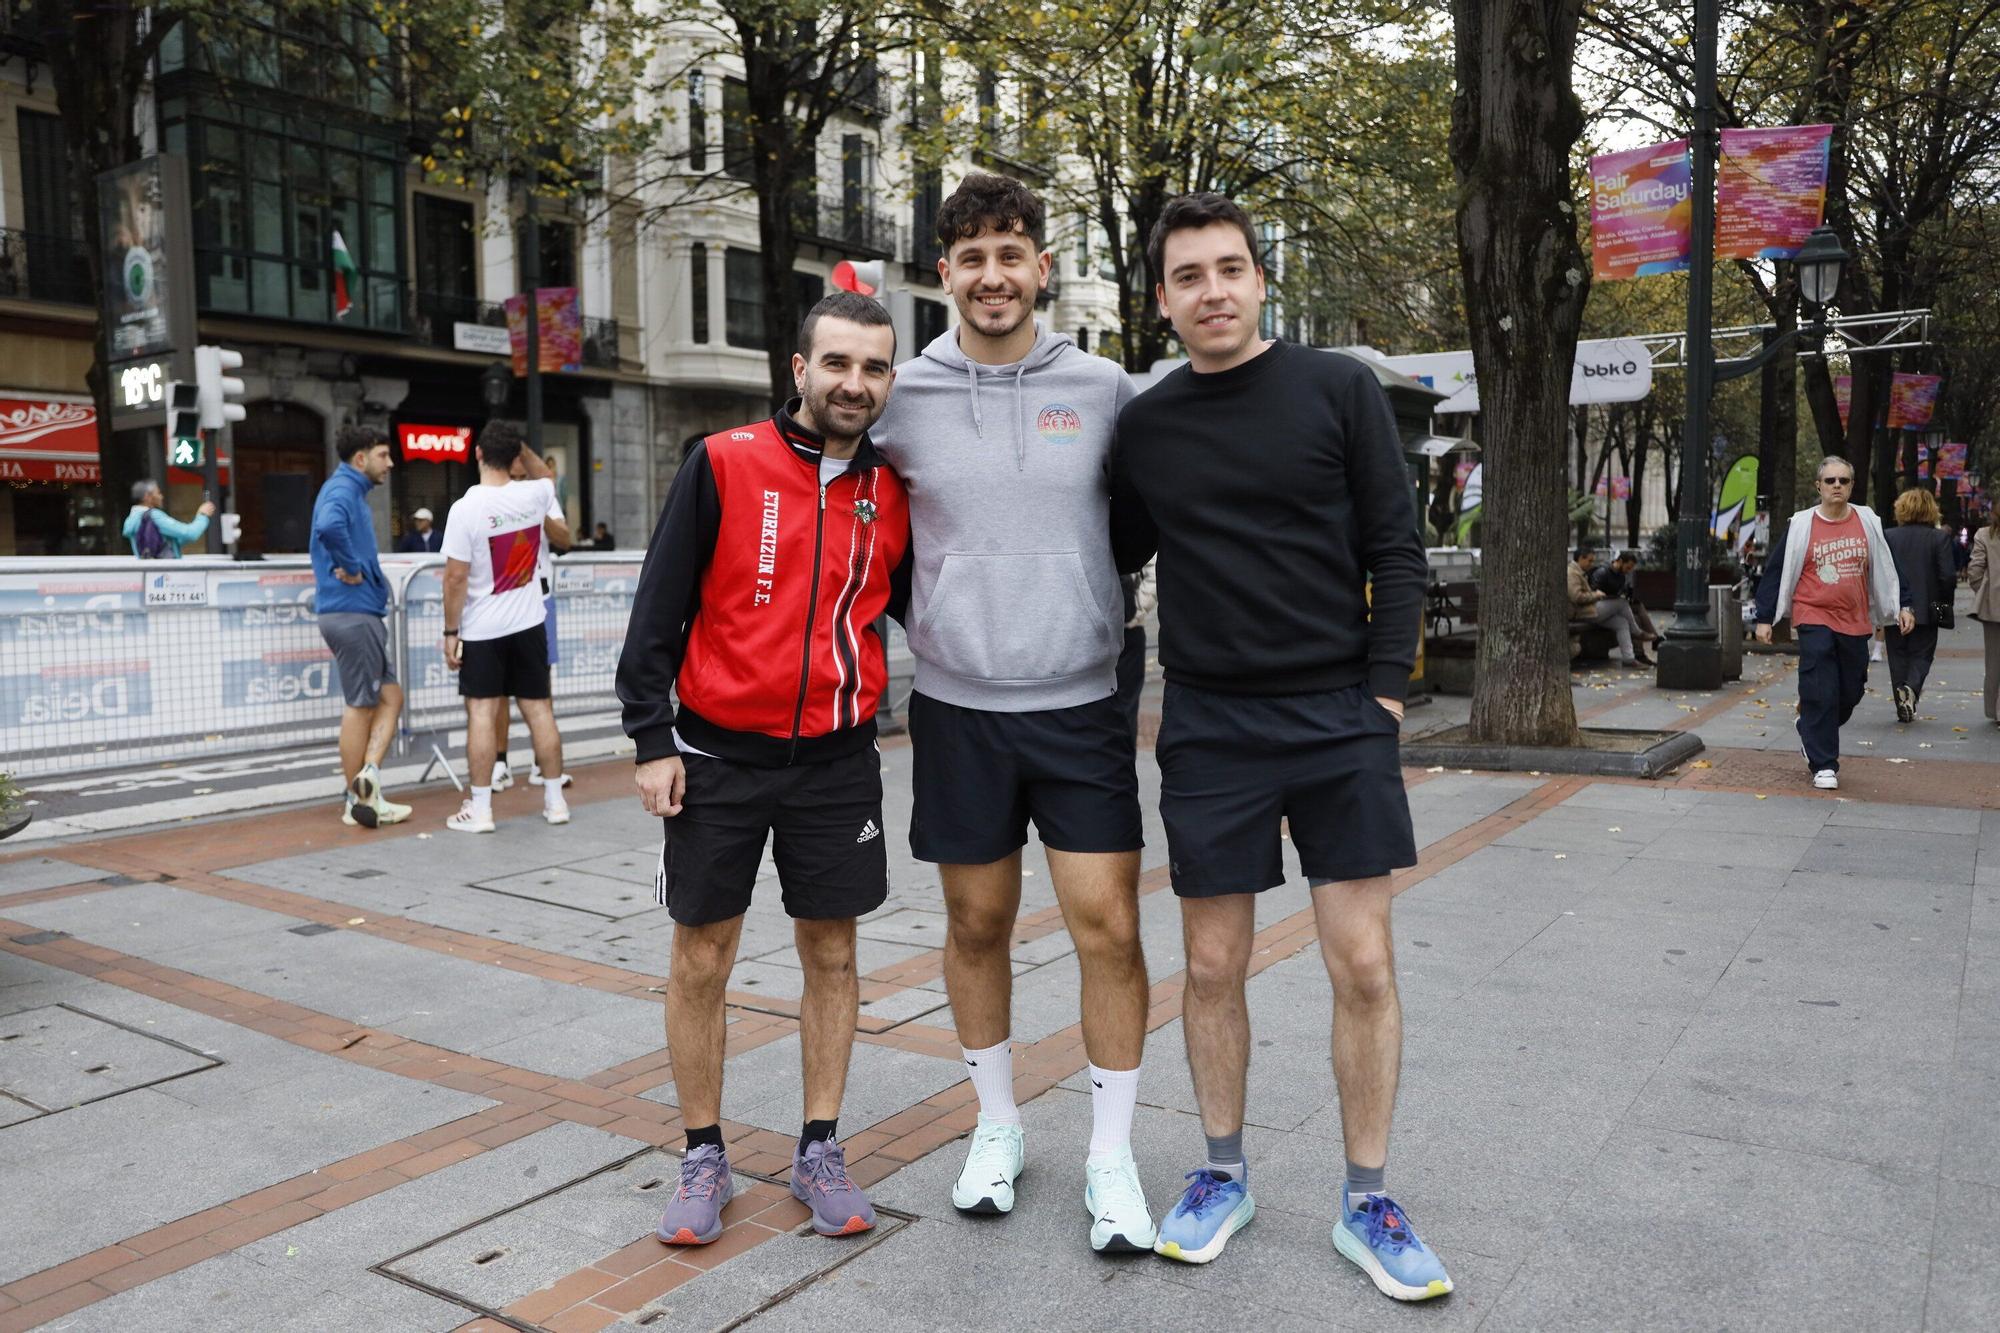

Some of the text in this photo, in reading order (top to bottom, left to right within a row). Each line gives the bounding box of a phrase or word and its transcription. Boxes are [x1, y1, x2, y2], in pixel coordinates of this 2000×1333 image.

[1594, 172, 1629, 193] Fair
[1596, 182, 1688, 211] Saturday
[1583, 363, 1620, 377] bbk
[55, 463, 98, 480] PAST
[758, 489, 779, 575] ETORKIZUN
[1813, 537, 1857, 559] MERRIE
[1816, 547, 1868, 570] MELODIES
[856, 828, 880, 843] adidas
